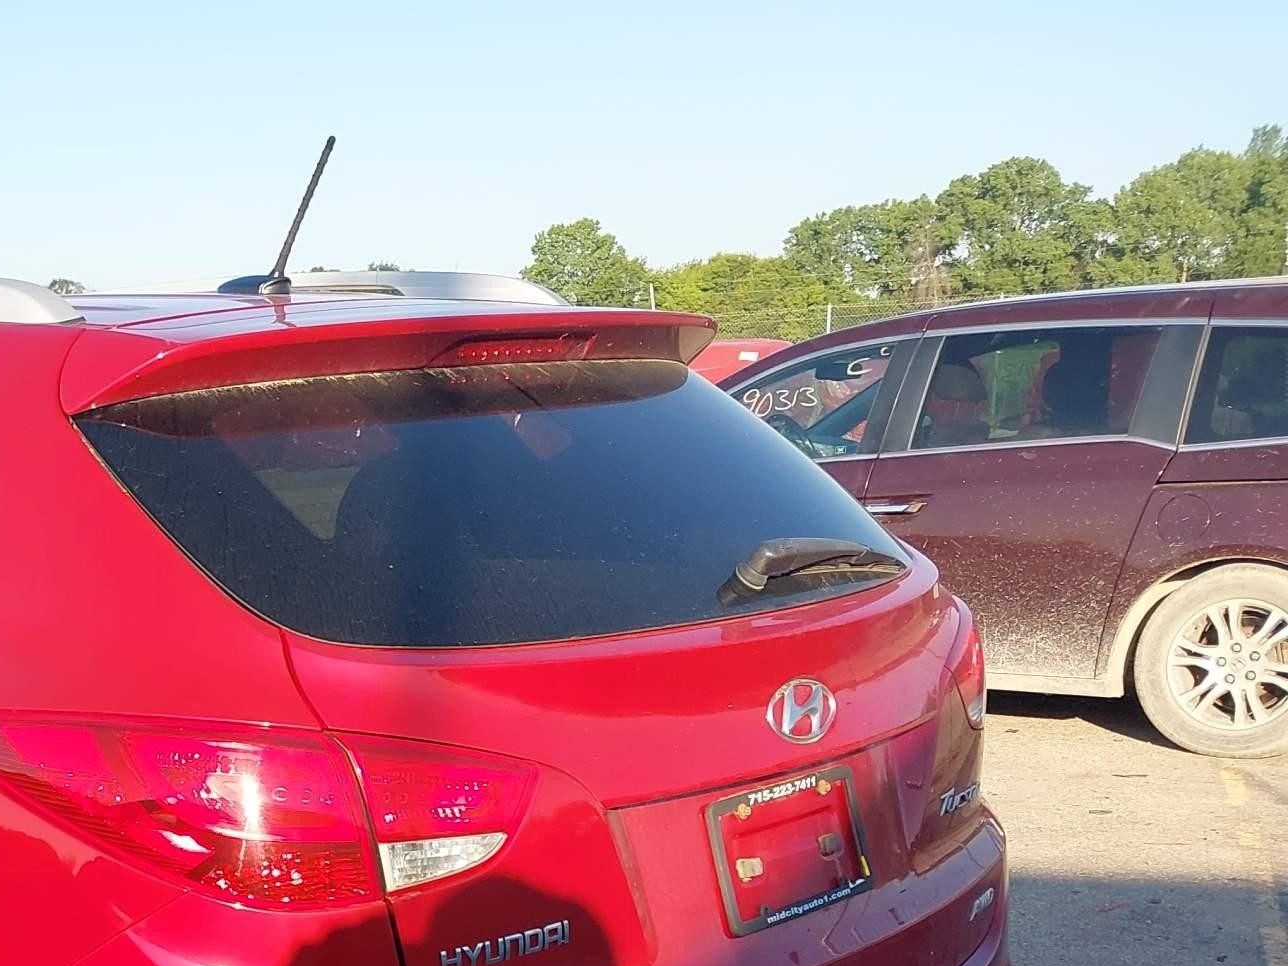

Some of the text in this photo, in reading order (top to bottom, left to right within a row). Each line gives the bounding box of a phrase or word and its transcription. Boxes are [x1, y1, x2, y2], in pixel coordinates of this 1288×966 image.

[743, 387, 818, 418] 90313
[747, 775, 817, 806] 715-223-7411
[767, 887, 851, 924] midcityauto1.com
